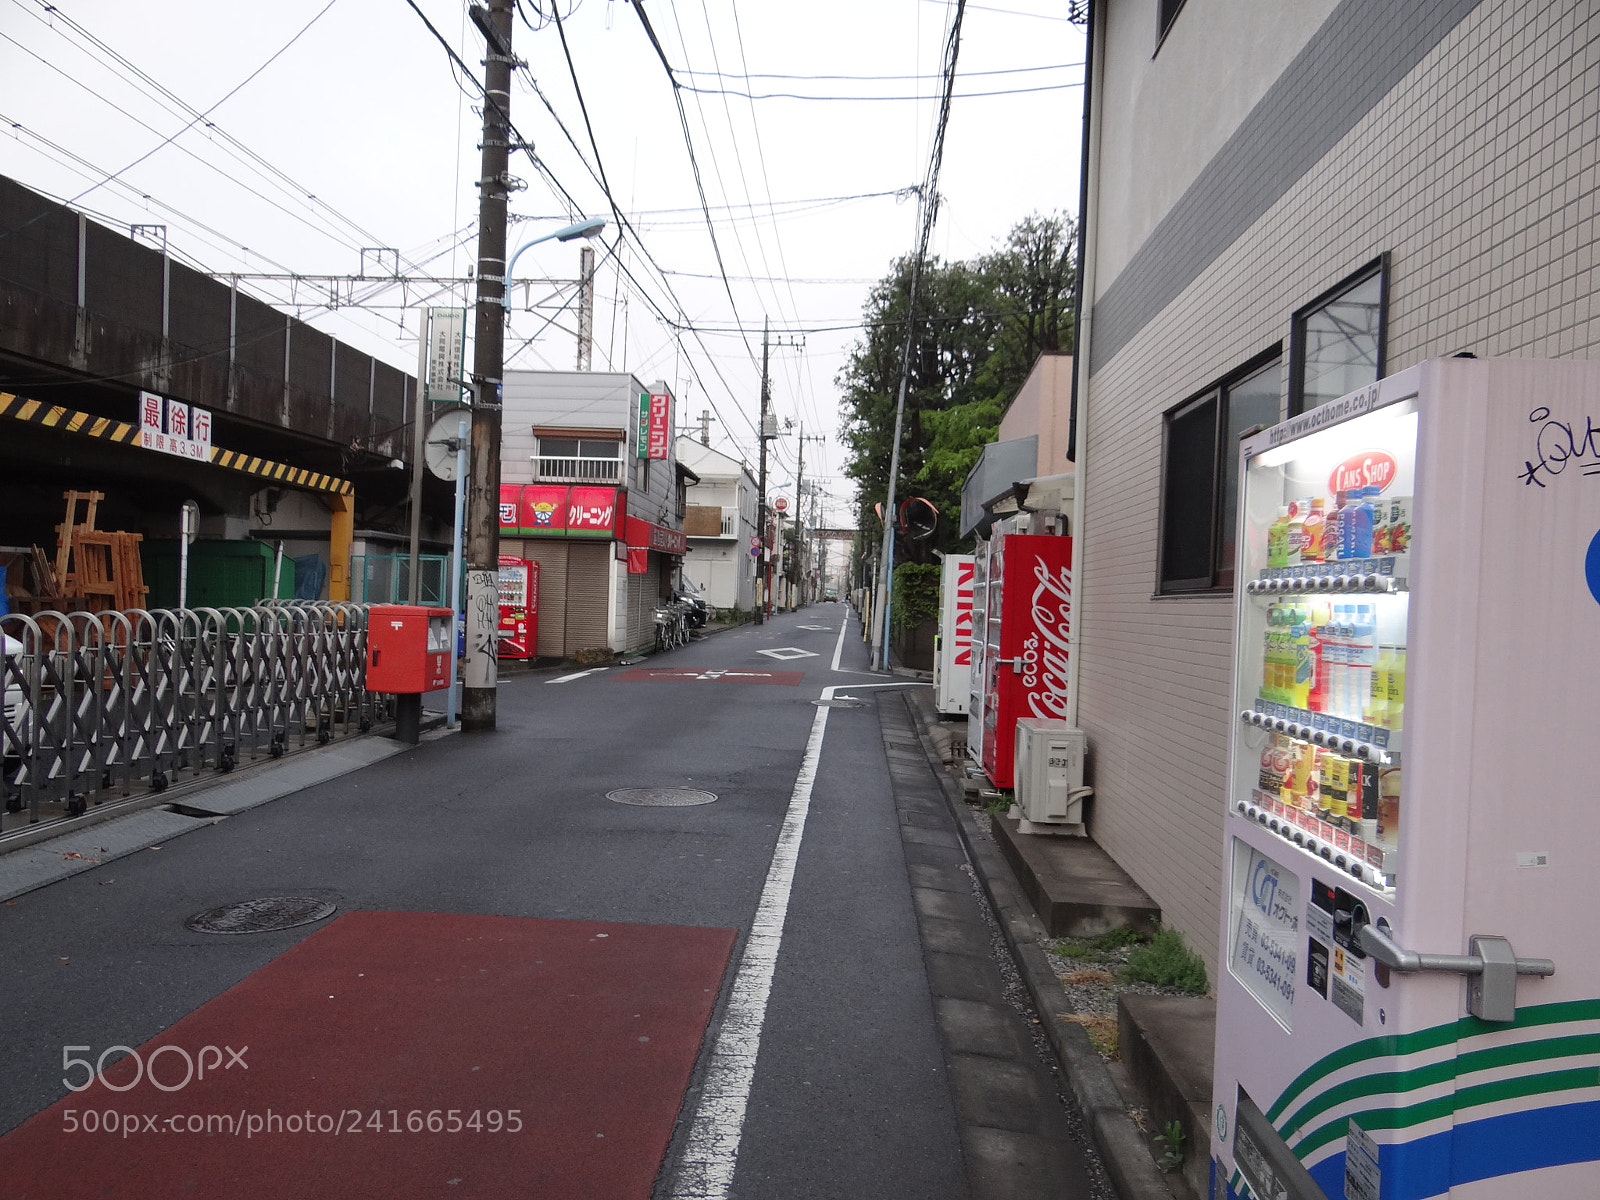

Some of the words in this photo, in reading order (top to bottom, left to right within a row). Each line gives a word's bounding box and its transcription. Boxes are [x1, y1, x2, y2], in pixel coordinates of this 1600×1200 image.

[144, 397, 210, 442] 最徐行
[650, 395, 667, 458] クリーニング
[1336, 465, 1361, 492] CANS
[1362, 458, 1390, 488] SHOP
[569, 505, 613, 527] クリーニング
